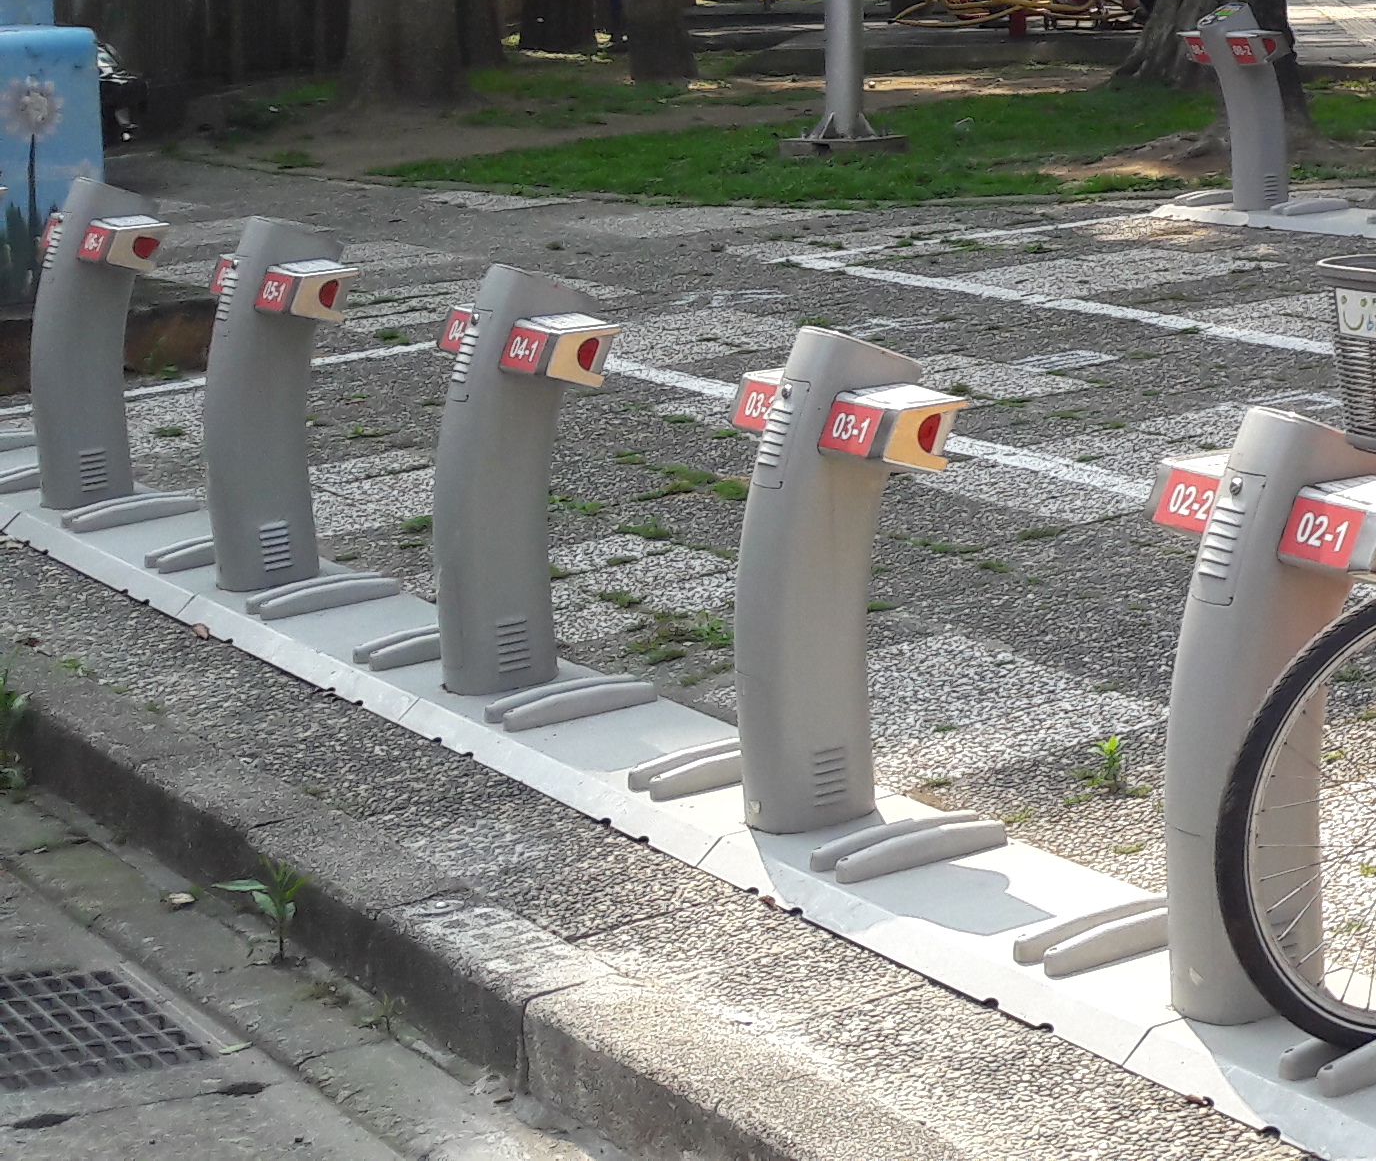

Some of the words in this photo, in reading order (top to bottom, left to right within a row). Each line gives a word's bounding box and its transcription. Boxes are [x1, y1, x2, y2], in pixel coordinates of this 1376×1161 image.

[262, 280, 287, 302] 05-1
[449, 320, 465, 341] 04-
[509, 336, 539, 363] 04-1
[832, 412, 871, 444] 03-1
[1169, 483, 1214, 521] 02-2
[1296, 511, 1350, 553] 02-1
